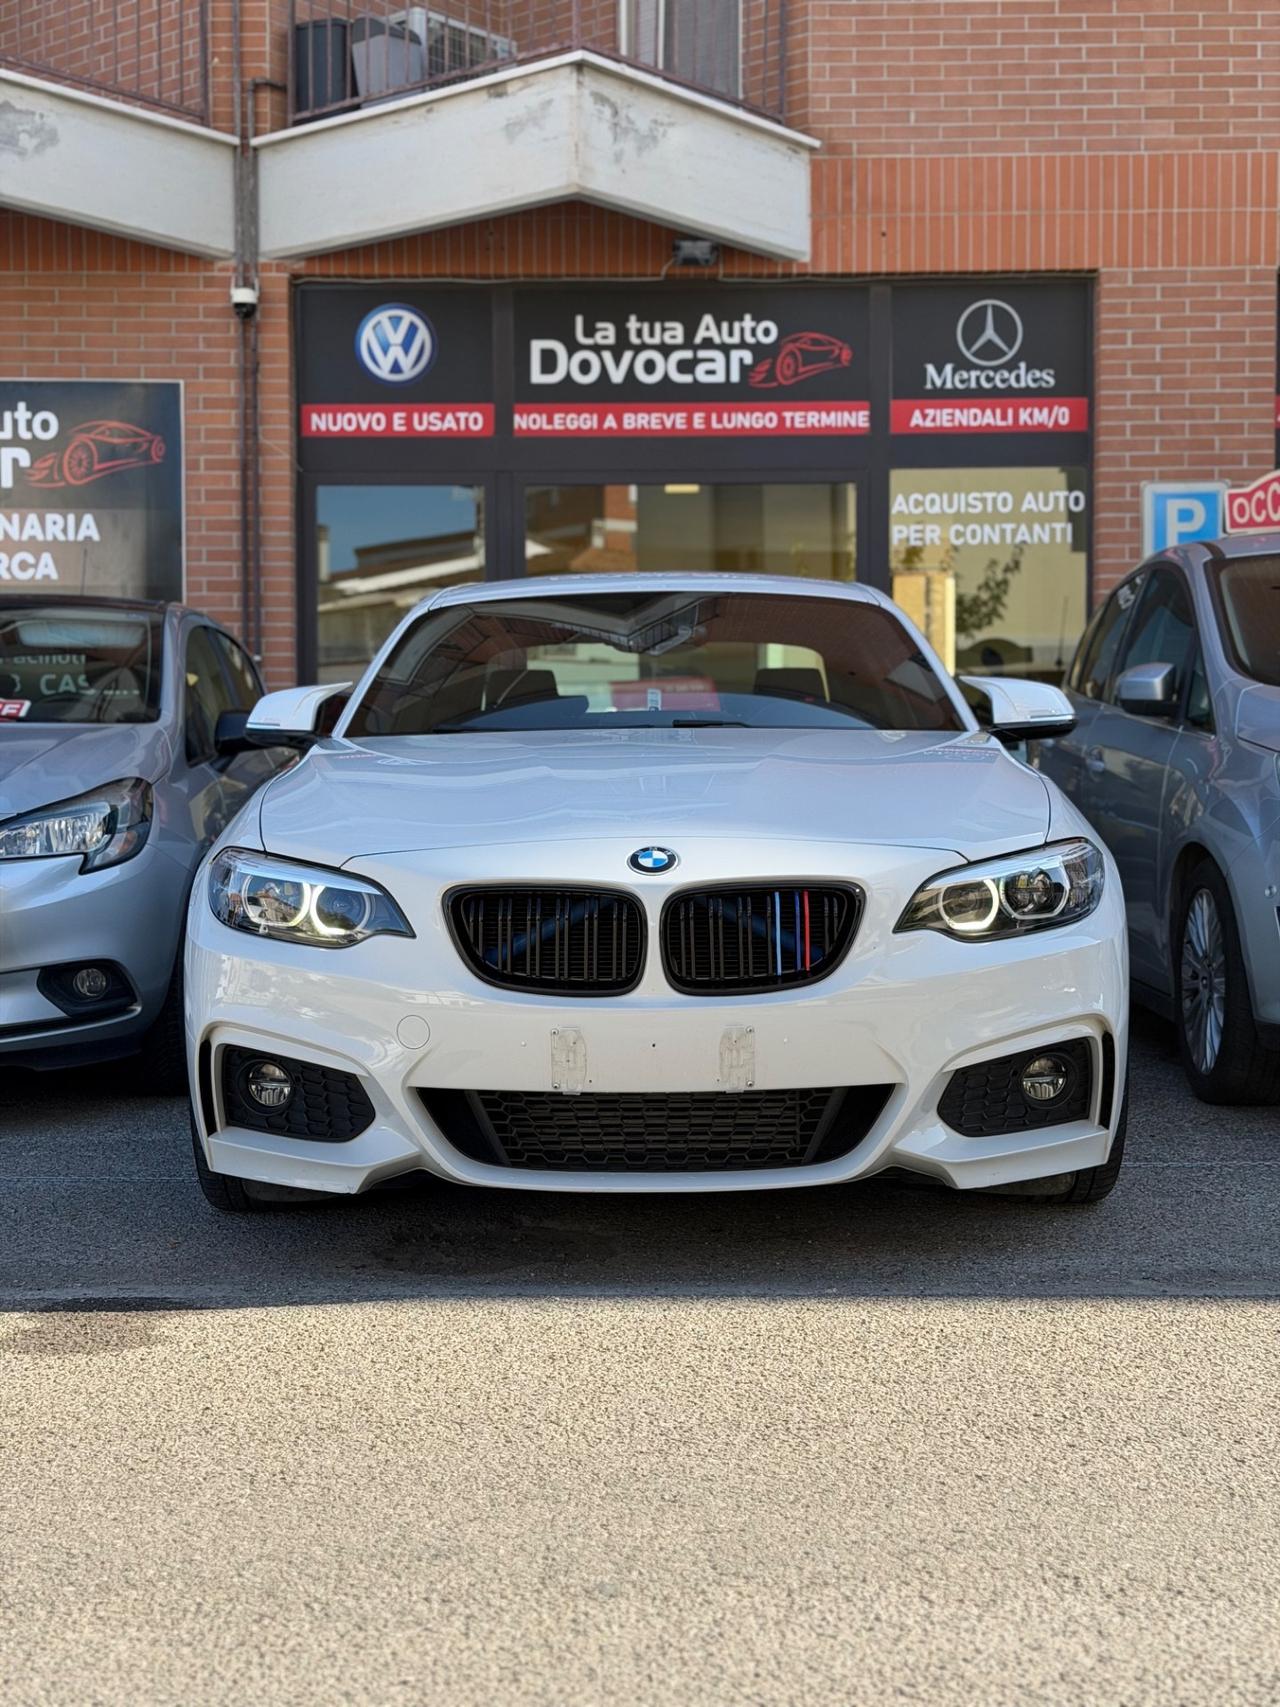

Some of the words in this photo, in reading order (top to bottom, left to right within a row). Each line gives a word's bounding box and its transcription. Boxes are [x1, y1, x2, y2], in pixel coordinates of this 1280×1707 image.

[575, 314, 616, 345] La
[626, 313, 685, 345] tua
[693, 313, 779, 345] Auto
[529, 338, 753, 385] Dovocar
[924, 361, 1056, 389] Mercedes
[310, 411, 386, 432] NUOVO
[392, 412, 407, 431] E
[413, 411, 484, 432] USATO
[513, 413, 598, 430] NOLEGGI
[603, 413, 618, 430] A
[623, 412, 687, 430] BREVE
[693, 412, 706, 429] E
[711, 411, 778, 429] LUNGO
[782, 410, 870, 428] TERMINE
[910, 407, 1013, 428] AZIENDALI
[1019, 406, 1070, 429] KM/0
[891, 491, 1013, 515] ACQUISTO
[1021, 490, 1085, 513] AUTO
[1232, 481, 1280, 524] OCC
[0, 512, 101, 542] NARIA
[892, 524, 941, 546] PER
[950, 522, 1073, 545] CONTANTI
[1165, 498, 1207, 546] P
